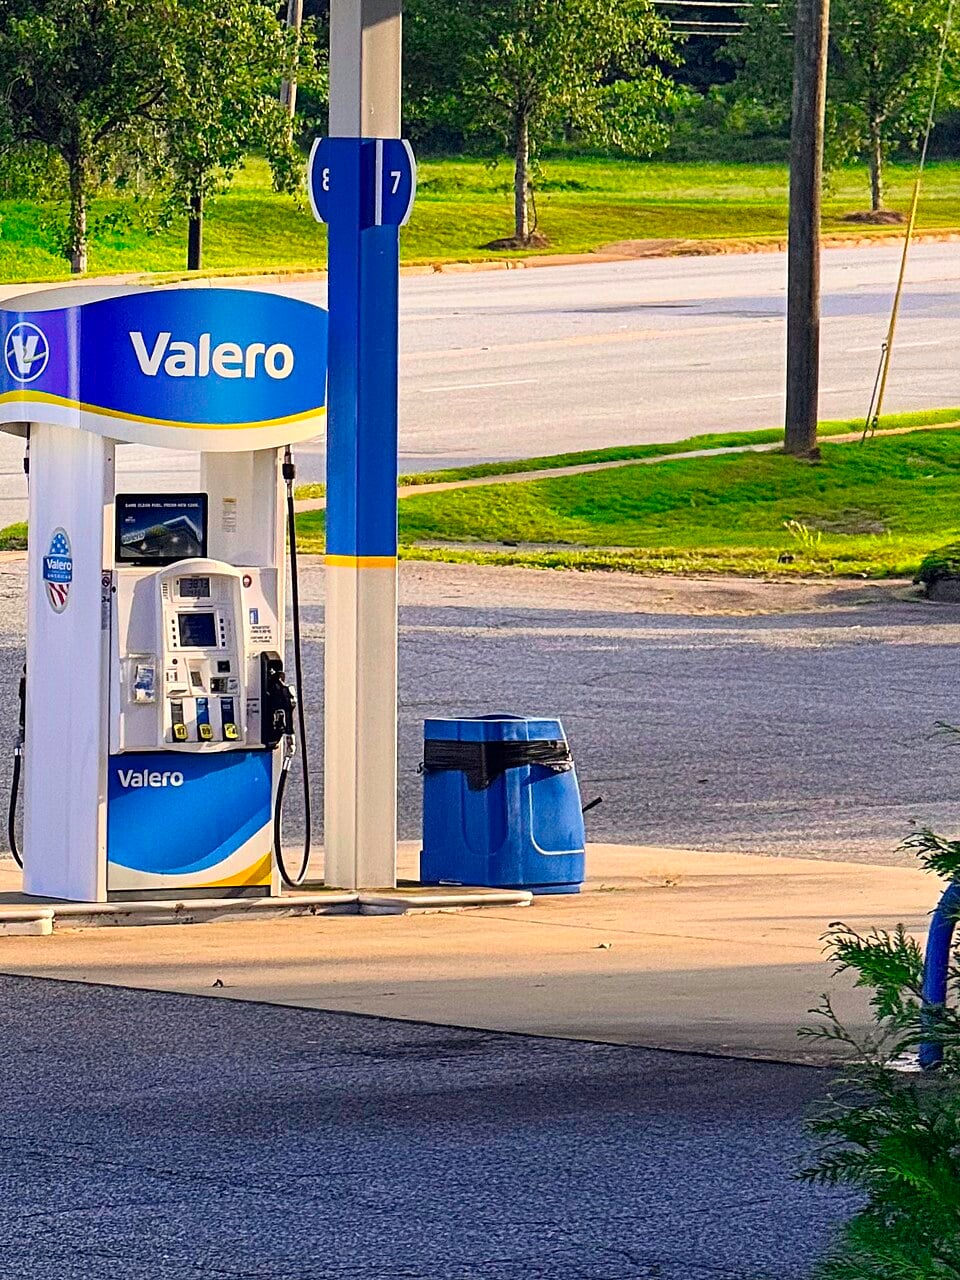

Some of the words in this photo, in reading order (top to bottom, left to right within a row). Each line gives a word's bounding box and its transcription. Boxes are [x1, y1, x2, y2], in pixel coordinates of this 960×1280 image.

[391, 171, 401, 194] 7
[129, 332, 294, 380] Valero
[46, 558, 72, 571] Valero
[117, 769, 184, 788] Valero
